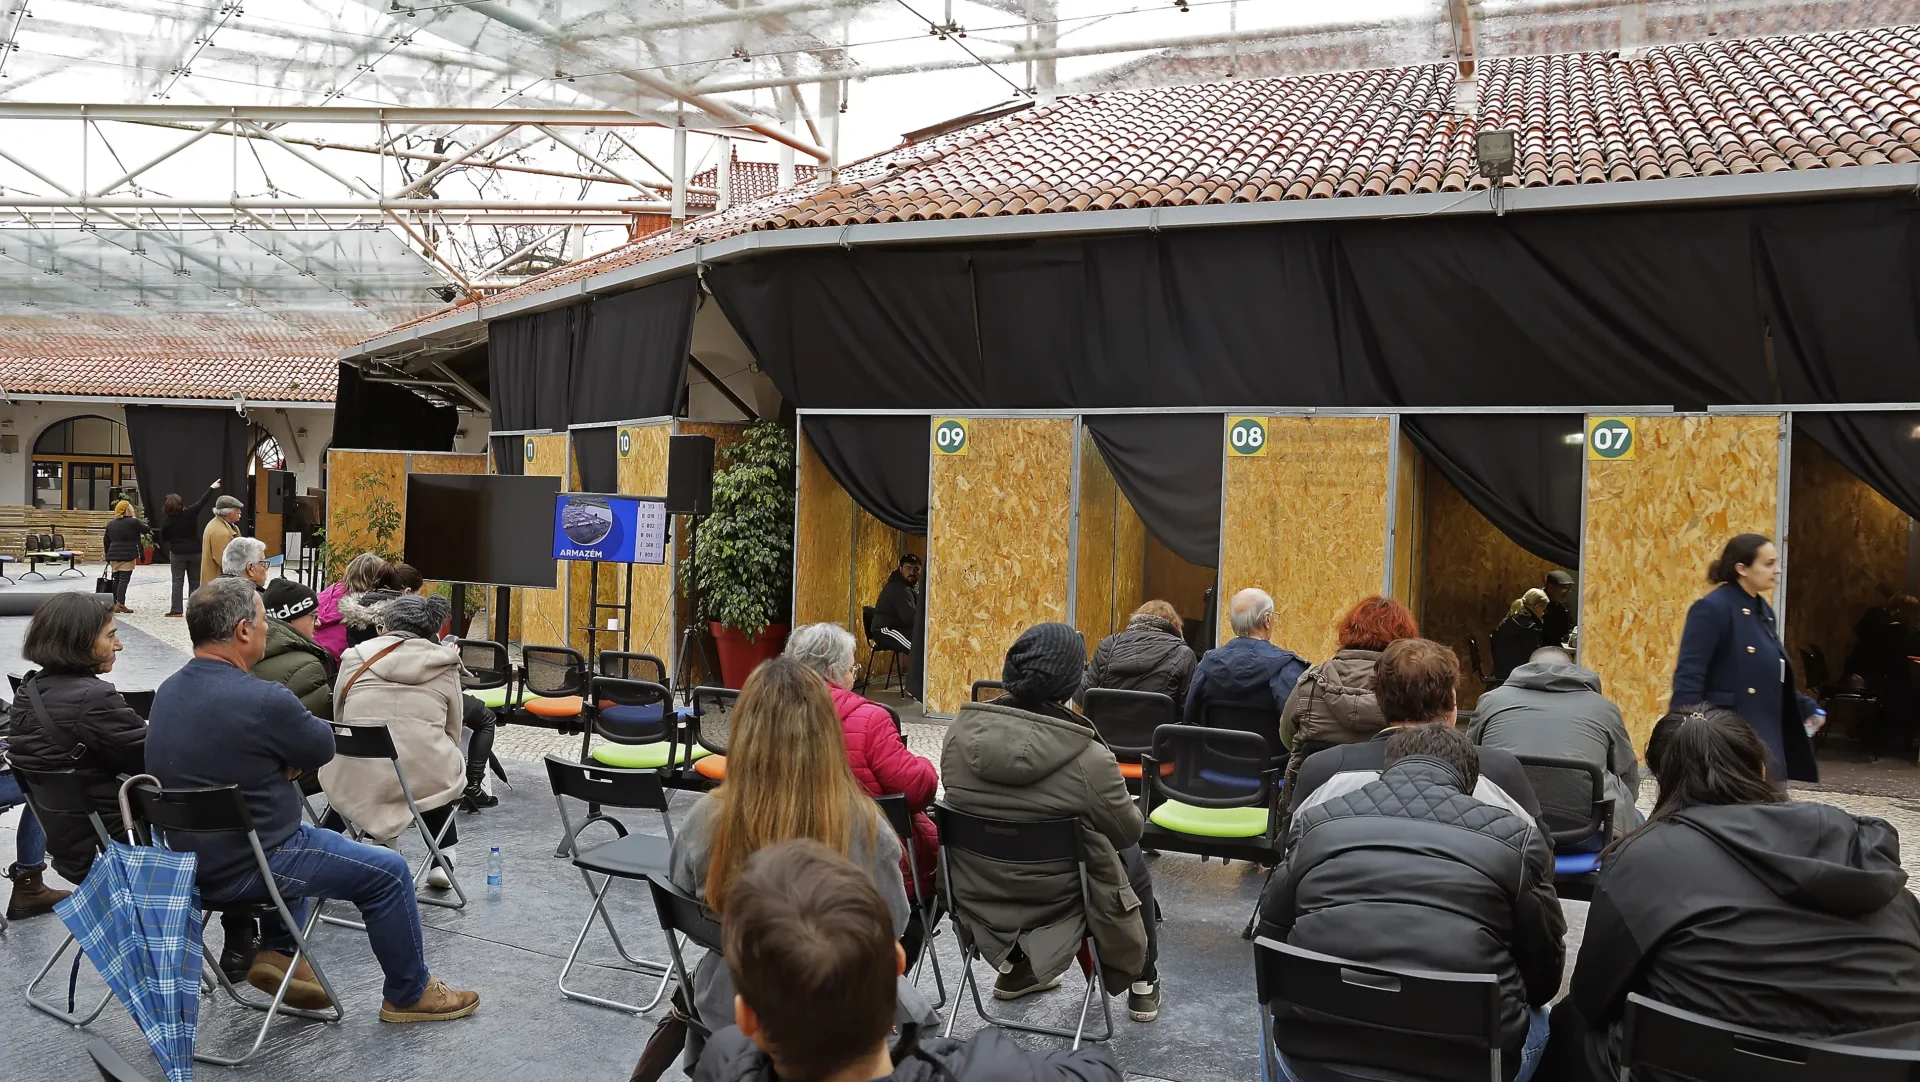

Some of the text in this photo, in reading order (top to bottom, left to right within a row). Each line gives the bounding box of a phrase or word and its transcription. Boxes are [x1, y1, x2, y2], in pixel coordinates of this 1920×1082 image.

[620, 435, 629, 452] 10
[937, 427, 964, 446] 09
[1232, 426, 1263, 447] 08
[1594, 427, 1629, 450] 07
[527, 443, 533, 457] 11
[560, 549, 603, 558] ARMAZÉM
[266, 597, 314, 619] idas
